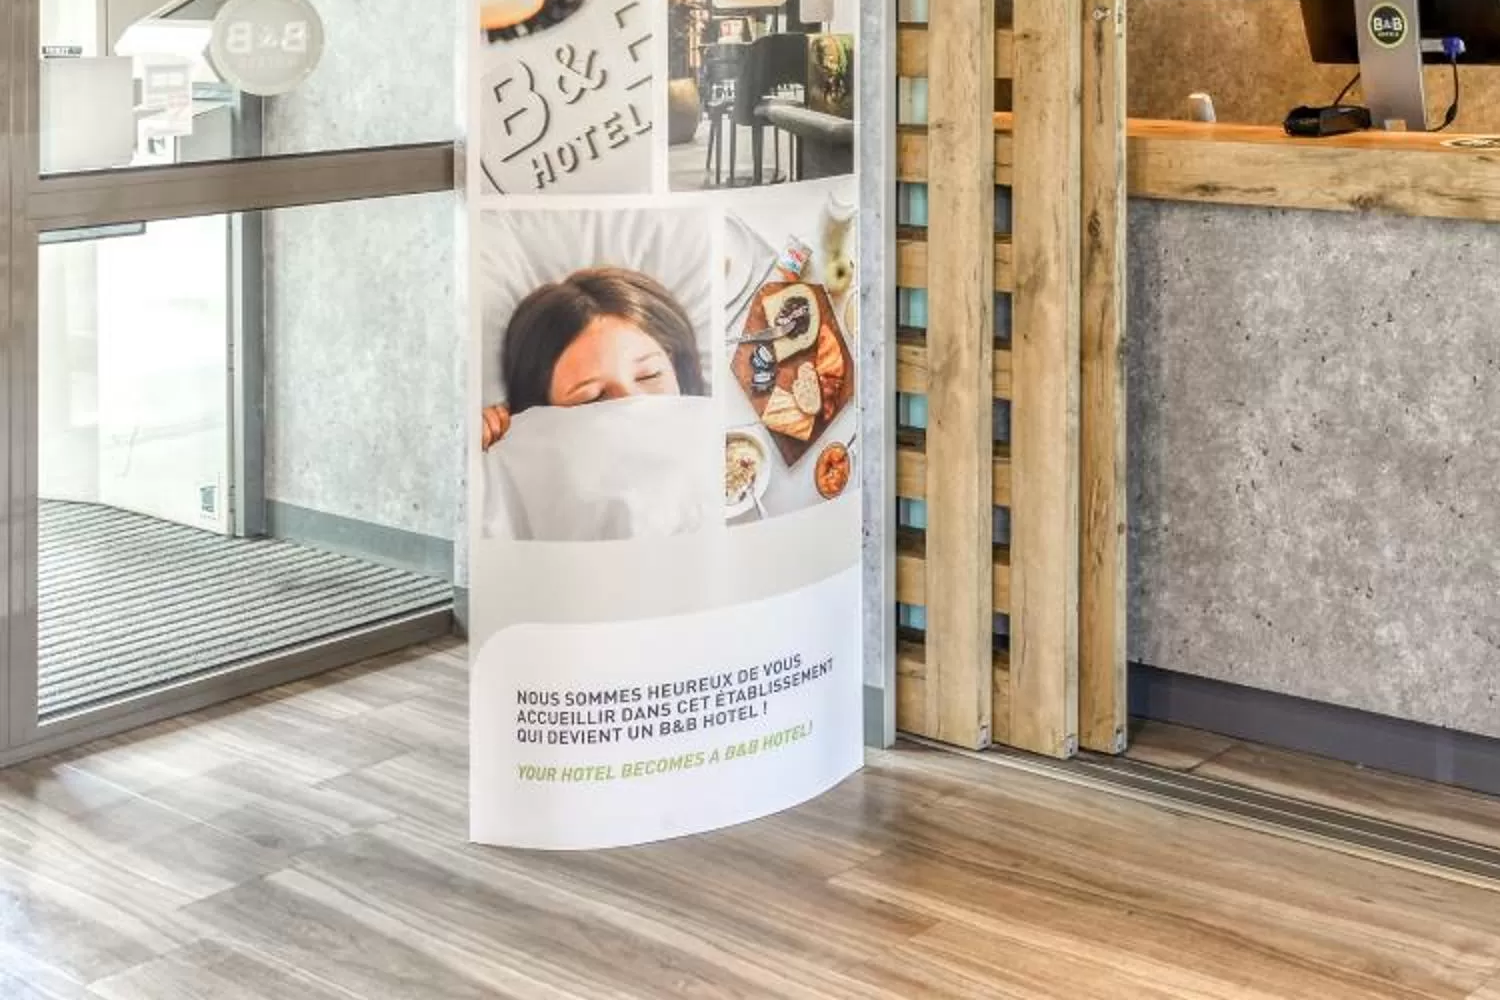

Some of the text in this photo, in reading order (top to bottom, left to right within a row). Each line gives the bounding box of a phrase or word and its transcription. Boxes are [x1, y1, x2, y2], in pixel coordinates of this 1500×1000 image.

[517, 653, 802, 706] NOUS SOMMES HEUREUX DE VOUS
[517, 657, 834, 725] ACCUEILLIR DANS CET ÉTABLISSEMENT
[517, 728, 543, 744] QUI
[547, 727, 623, 745] DEVIENT
[628, 724, 653, 741] UN
[659, 717, 697, 735] B&B
[703, 705, 758, 729] HOTEL
[518, 764, 558, 782] YOUR
[560, 764, 617, 783] HOTEL
[621, 751, 705, 778] BECOMES
[708, 748, 720, 765] A
[725, 739, 759, 760] B&B
